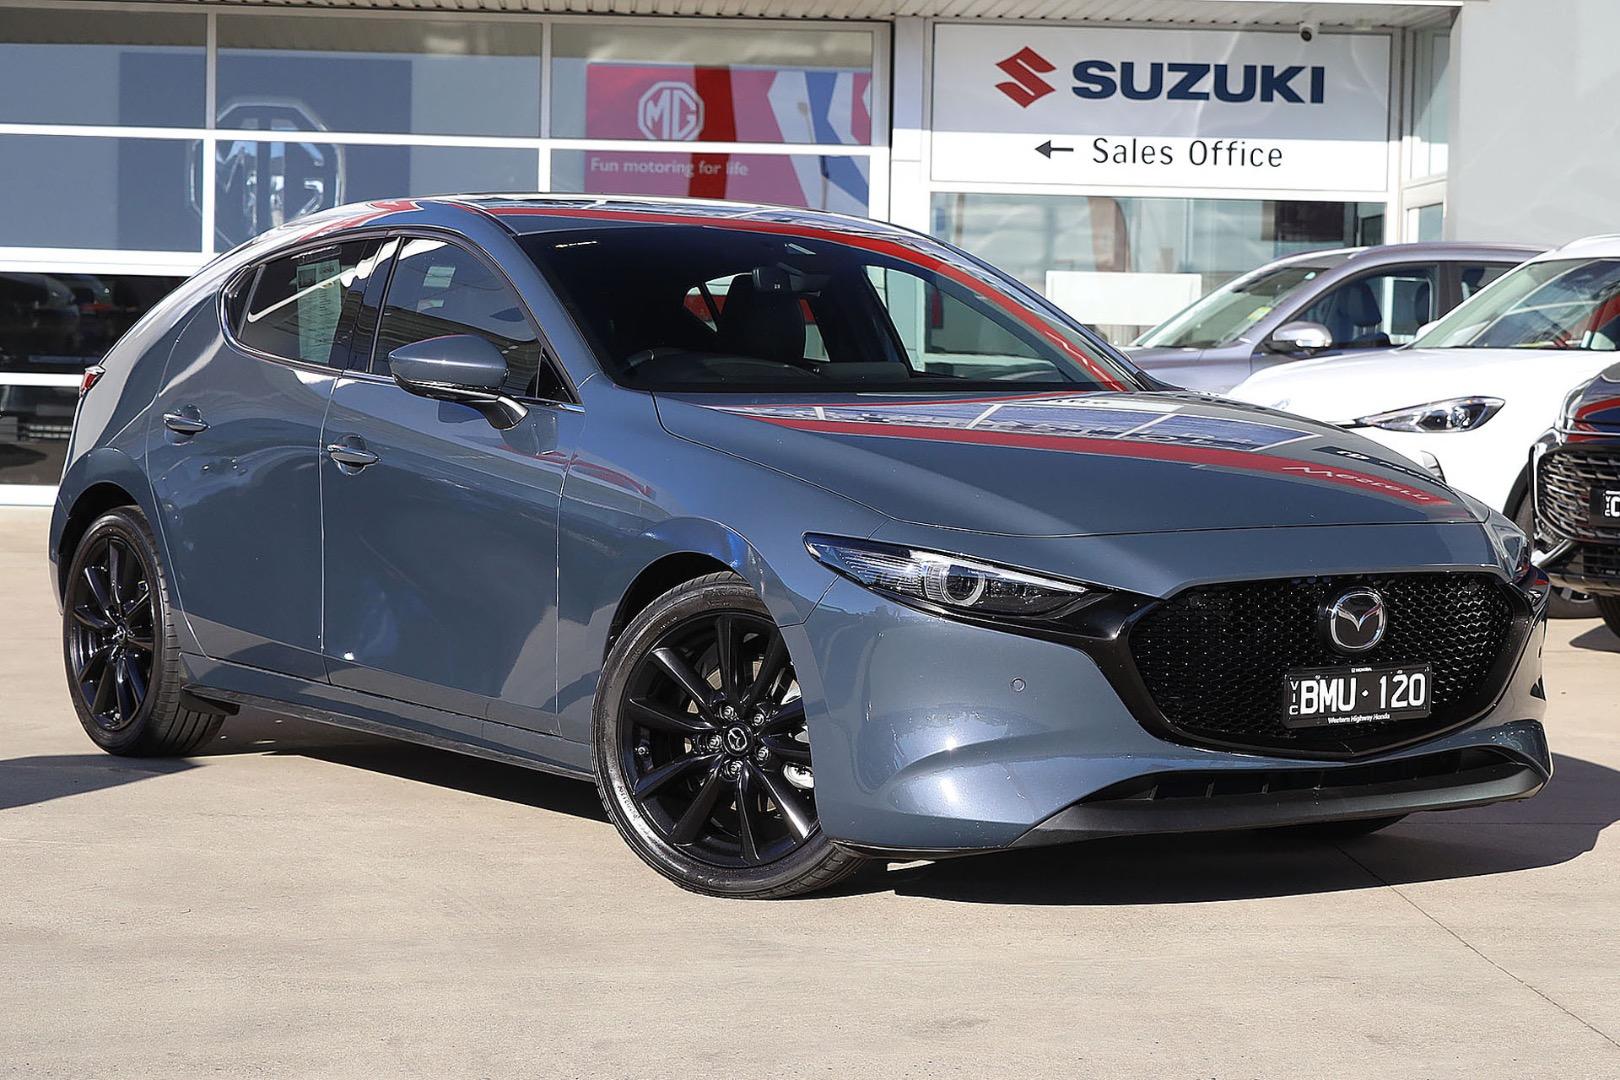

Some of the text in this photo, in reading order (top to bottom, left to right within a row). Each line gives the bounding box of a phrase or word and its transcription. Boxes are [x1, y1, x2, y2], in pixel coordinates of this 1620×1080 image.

[1072, 60, 1325, 104] SUZUKI
[646, 89, 697, 140] MG
[1092, 137, 1283, 167] Sales Office
[590, 159, 749, 177] Fun motoring for life
[1373, 712, 1390, 720] Honda
